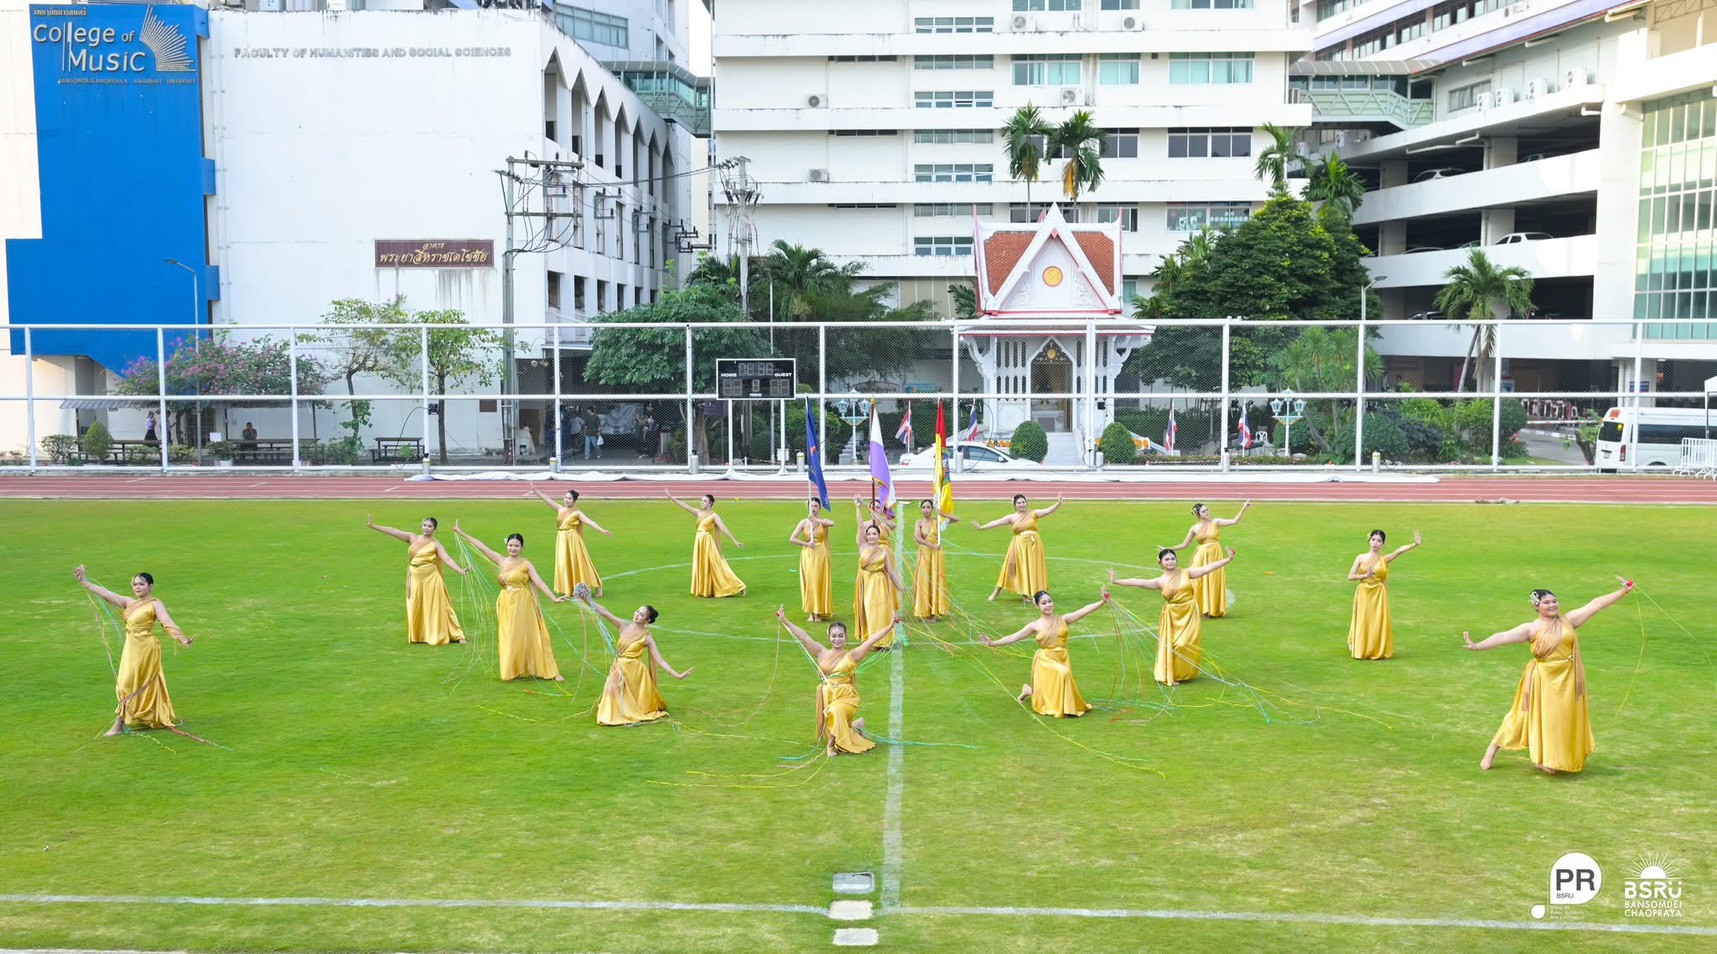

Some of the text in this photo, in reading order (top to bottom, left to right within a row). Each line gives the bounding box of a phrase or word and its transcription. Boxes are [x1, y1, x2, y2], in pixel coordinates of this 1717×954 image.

[33, 21, 135, 47] College of
[234, 47, 512, 58] FACULTY OF HUMANITIES AND SOCIAL SCIENCES
[422, 242, 446, 250] อาคาร
